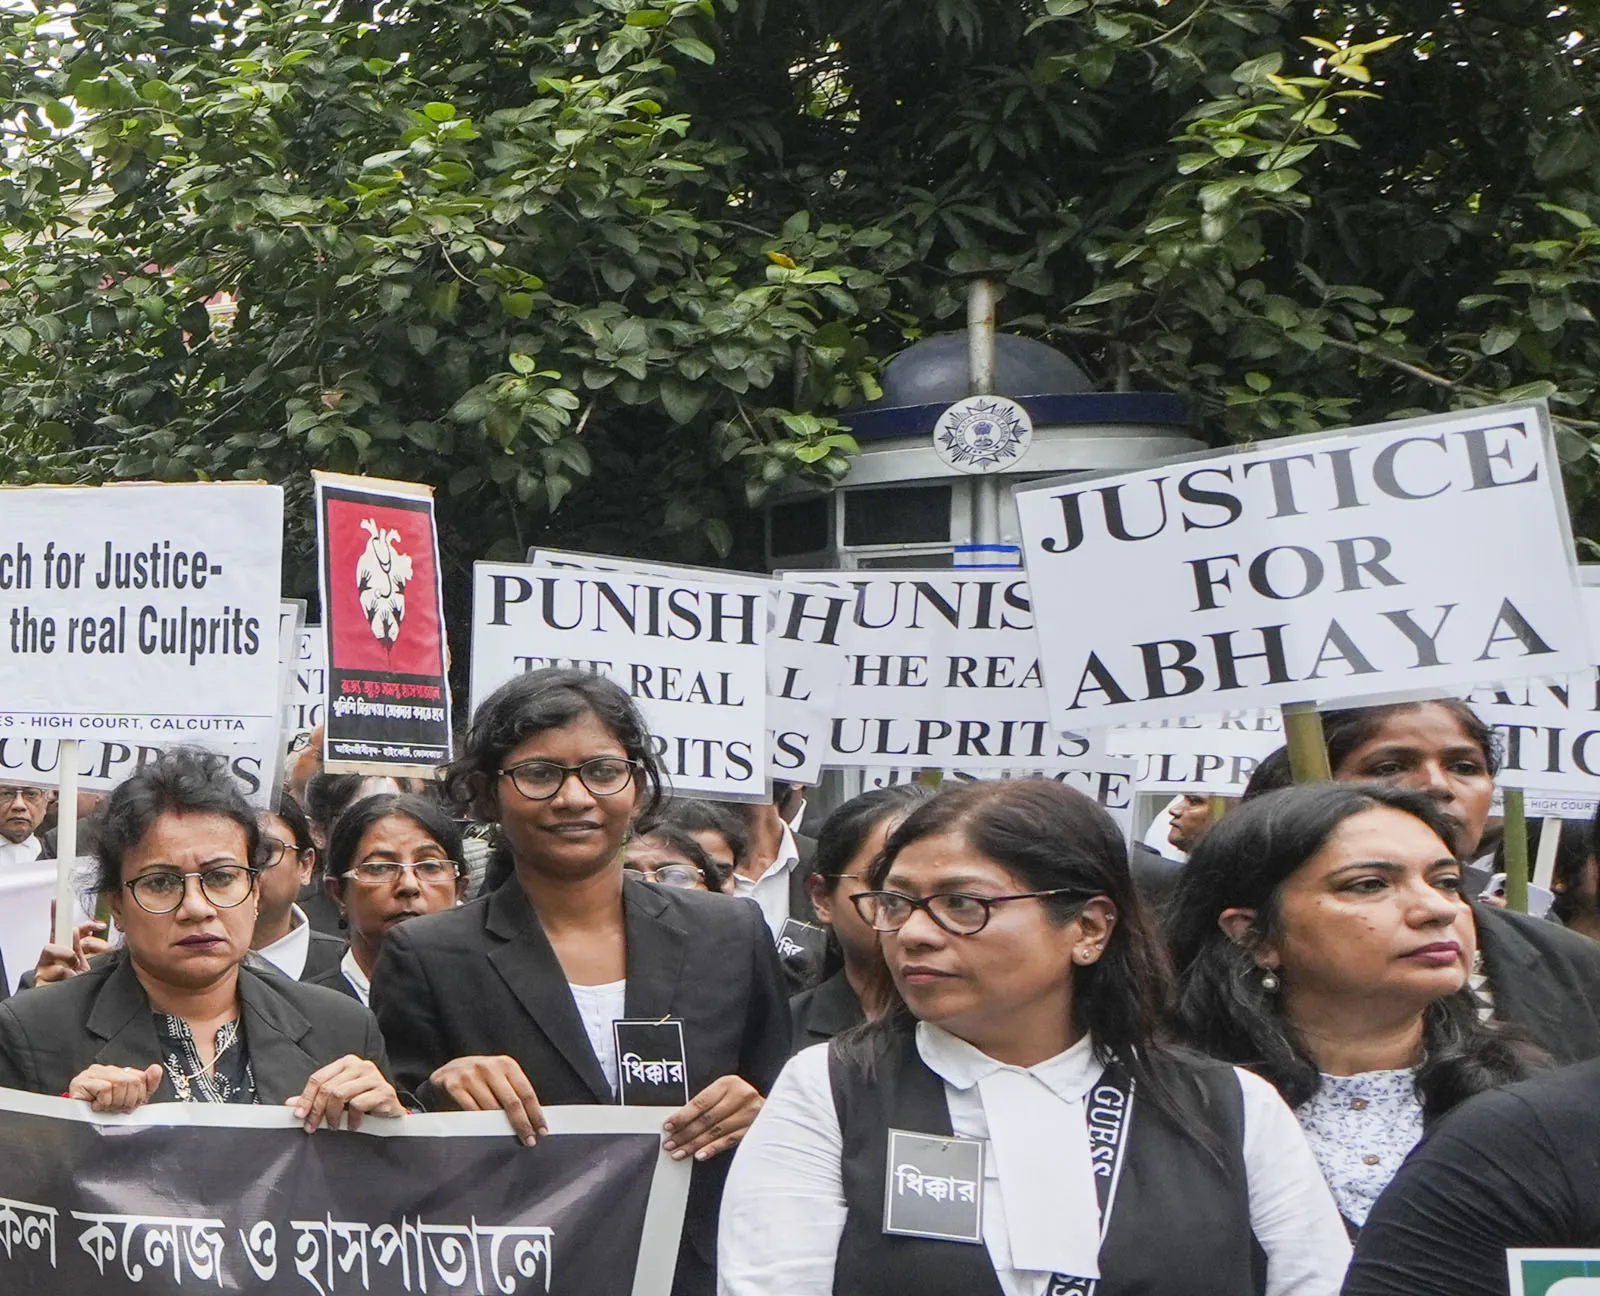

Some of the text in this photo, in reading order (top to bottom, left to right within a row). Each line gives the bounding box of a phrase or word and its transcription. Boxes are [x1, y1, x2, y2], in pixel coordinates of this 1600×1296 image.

[1041, 421, 1540, 554] JUSTICE
[44, 541, 86, 590] for
[95, 540, 223, 590] Justice-
[1183, 536, 1406, 612] FOR
[10, 606, 56, 654] the
[68, 605, 126, 654] real
[138, 604, 260, 666] Culprits
[487, 574, 761, 645] PUNISH
[629, 663, 745, 707] REAL
[1065, 597, 1559, 711] ABHAYA
[31, 716, 73, 728] HIGH
[79, 717, 144, 731] COURT,
[150, 717, 246, 731] CALCUTTA
[622, 1052, 683, 1086] ধিক্কার
[894, 1163, 977, 1204] ধিক্কার
[70, 1210, 226, 1289] কলেজ
[240, 1219, 278, 1282] ও
